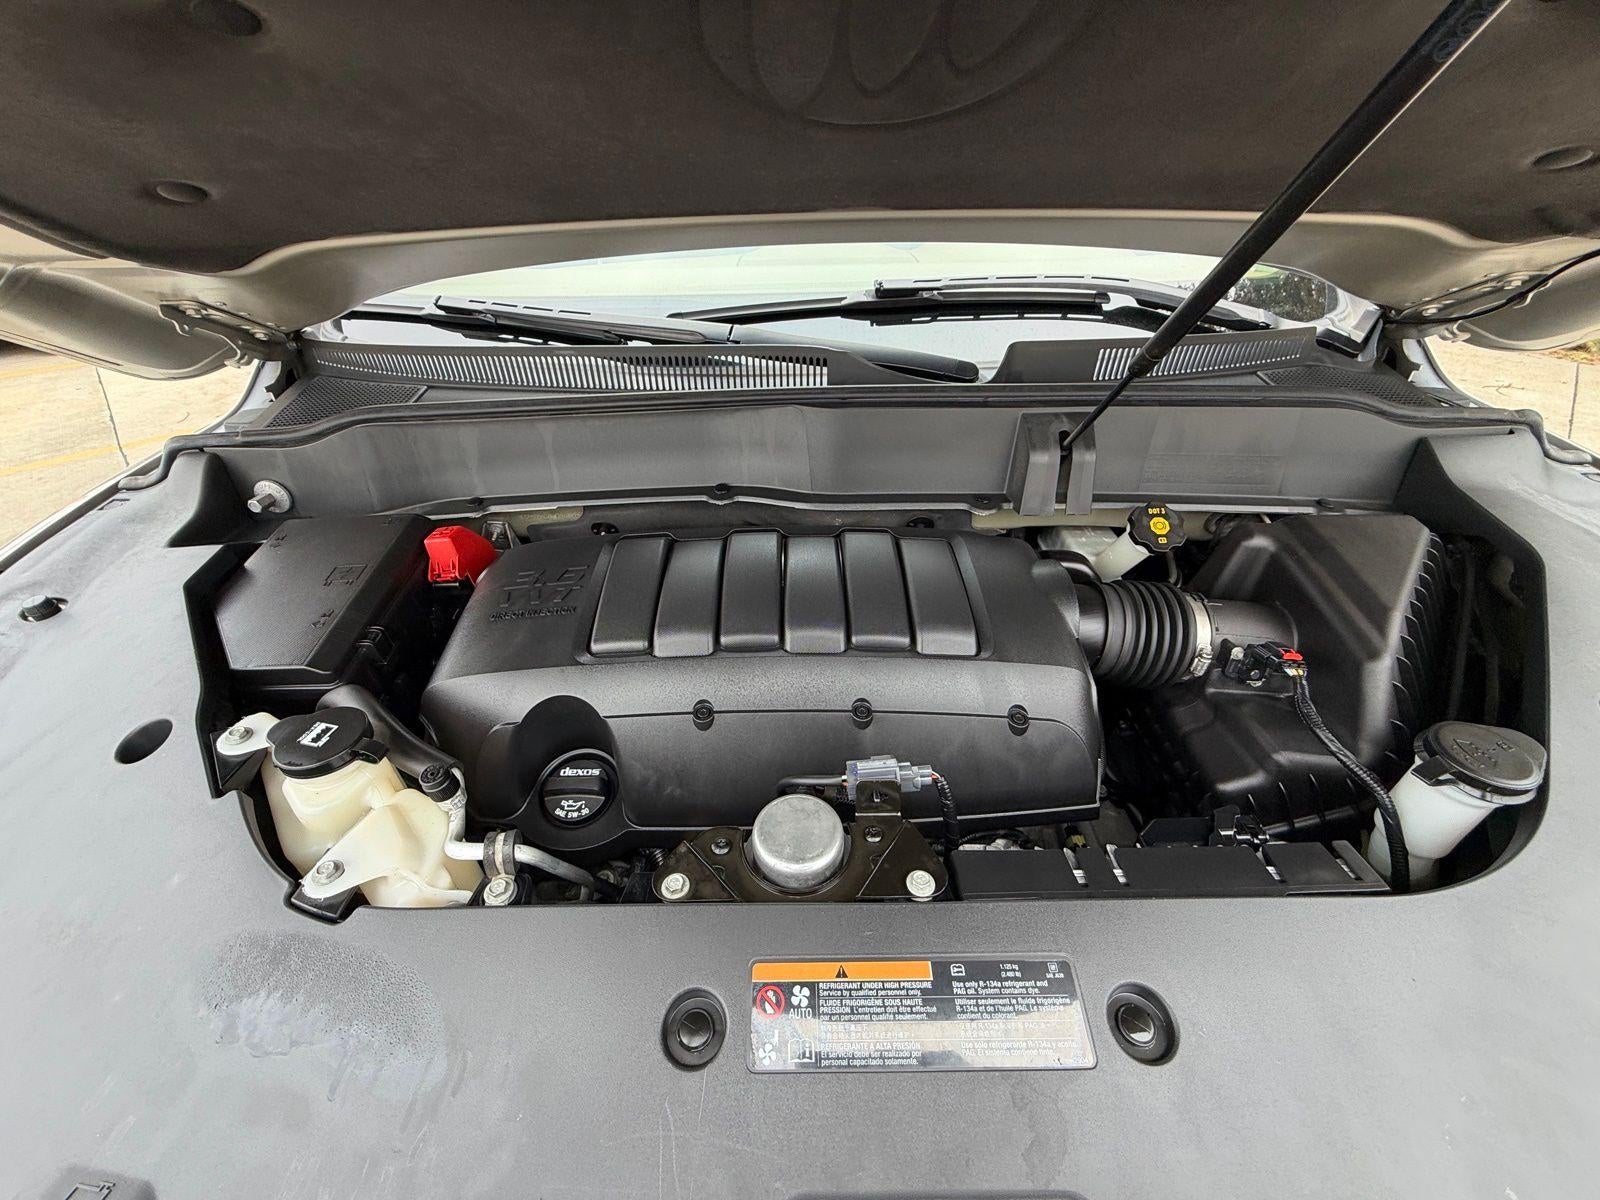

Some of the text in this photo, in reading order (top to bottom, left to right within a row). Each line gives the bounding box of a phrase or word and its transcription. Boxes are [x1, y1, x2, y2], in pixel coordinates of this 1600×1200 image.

[560, 767, 602, 776] dexos
[555, 807, 567, 817] SAE
[965, 980, 978, 988] only
[1002, 980, 1035, 988] refrigerant
[851, 989, 877, 997] qualified
[820, 998, 841, 1006] FLUIDE
[1018, 997, 1035, 1005] fluide
[789, 1007, 812, 1019] AUTO
[875, 1042, 892, 1050] ALTA
[912, 1050, 922, 1058] por
[821, 1057, 919, 1067] personal capacitado solamente.
